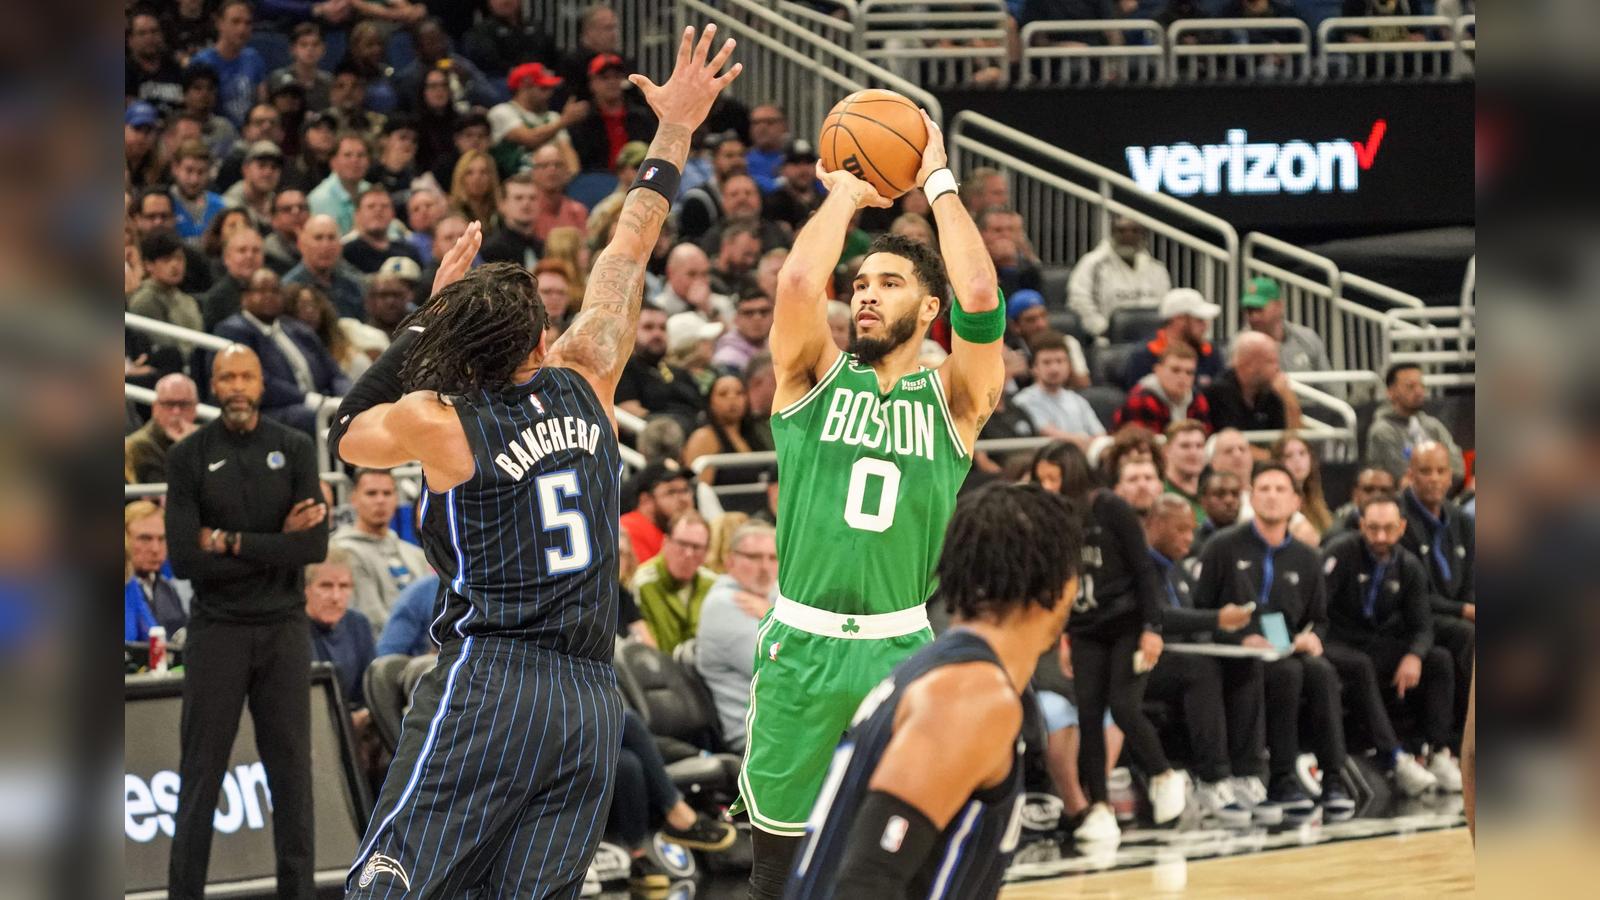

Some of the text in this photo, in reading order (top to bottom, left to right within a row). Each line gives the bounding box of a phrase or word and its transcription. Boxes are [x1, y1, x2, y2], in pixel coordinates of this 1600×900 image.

[1124, 128, 1359, 197] verizon
[494, 416, 600, 482] BANCHERO
[820, 387, 934, 461] BOSTON
[535, 468, 592, 576] 5
[844, 457, 901, 532] 0
